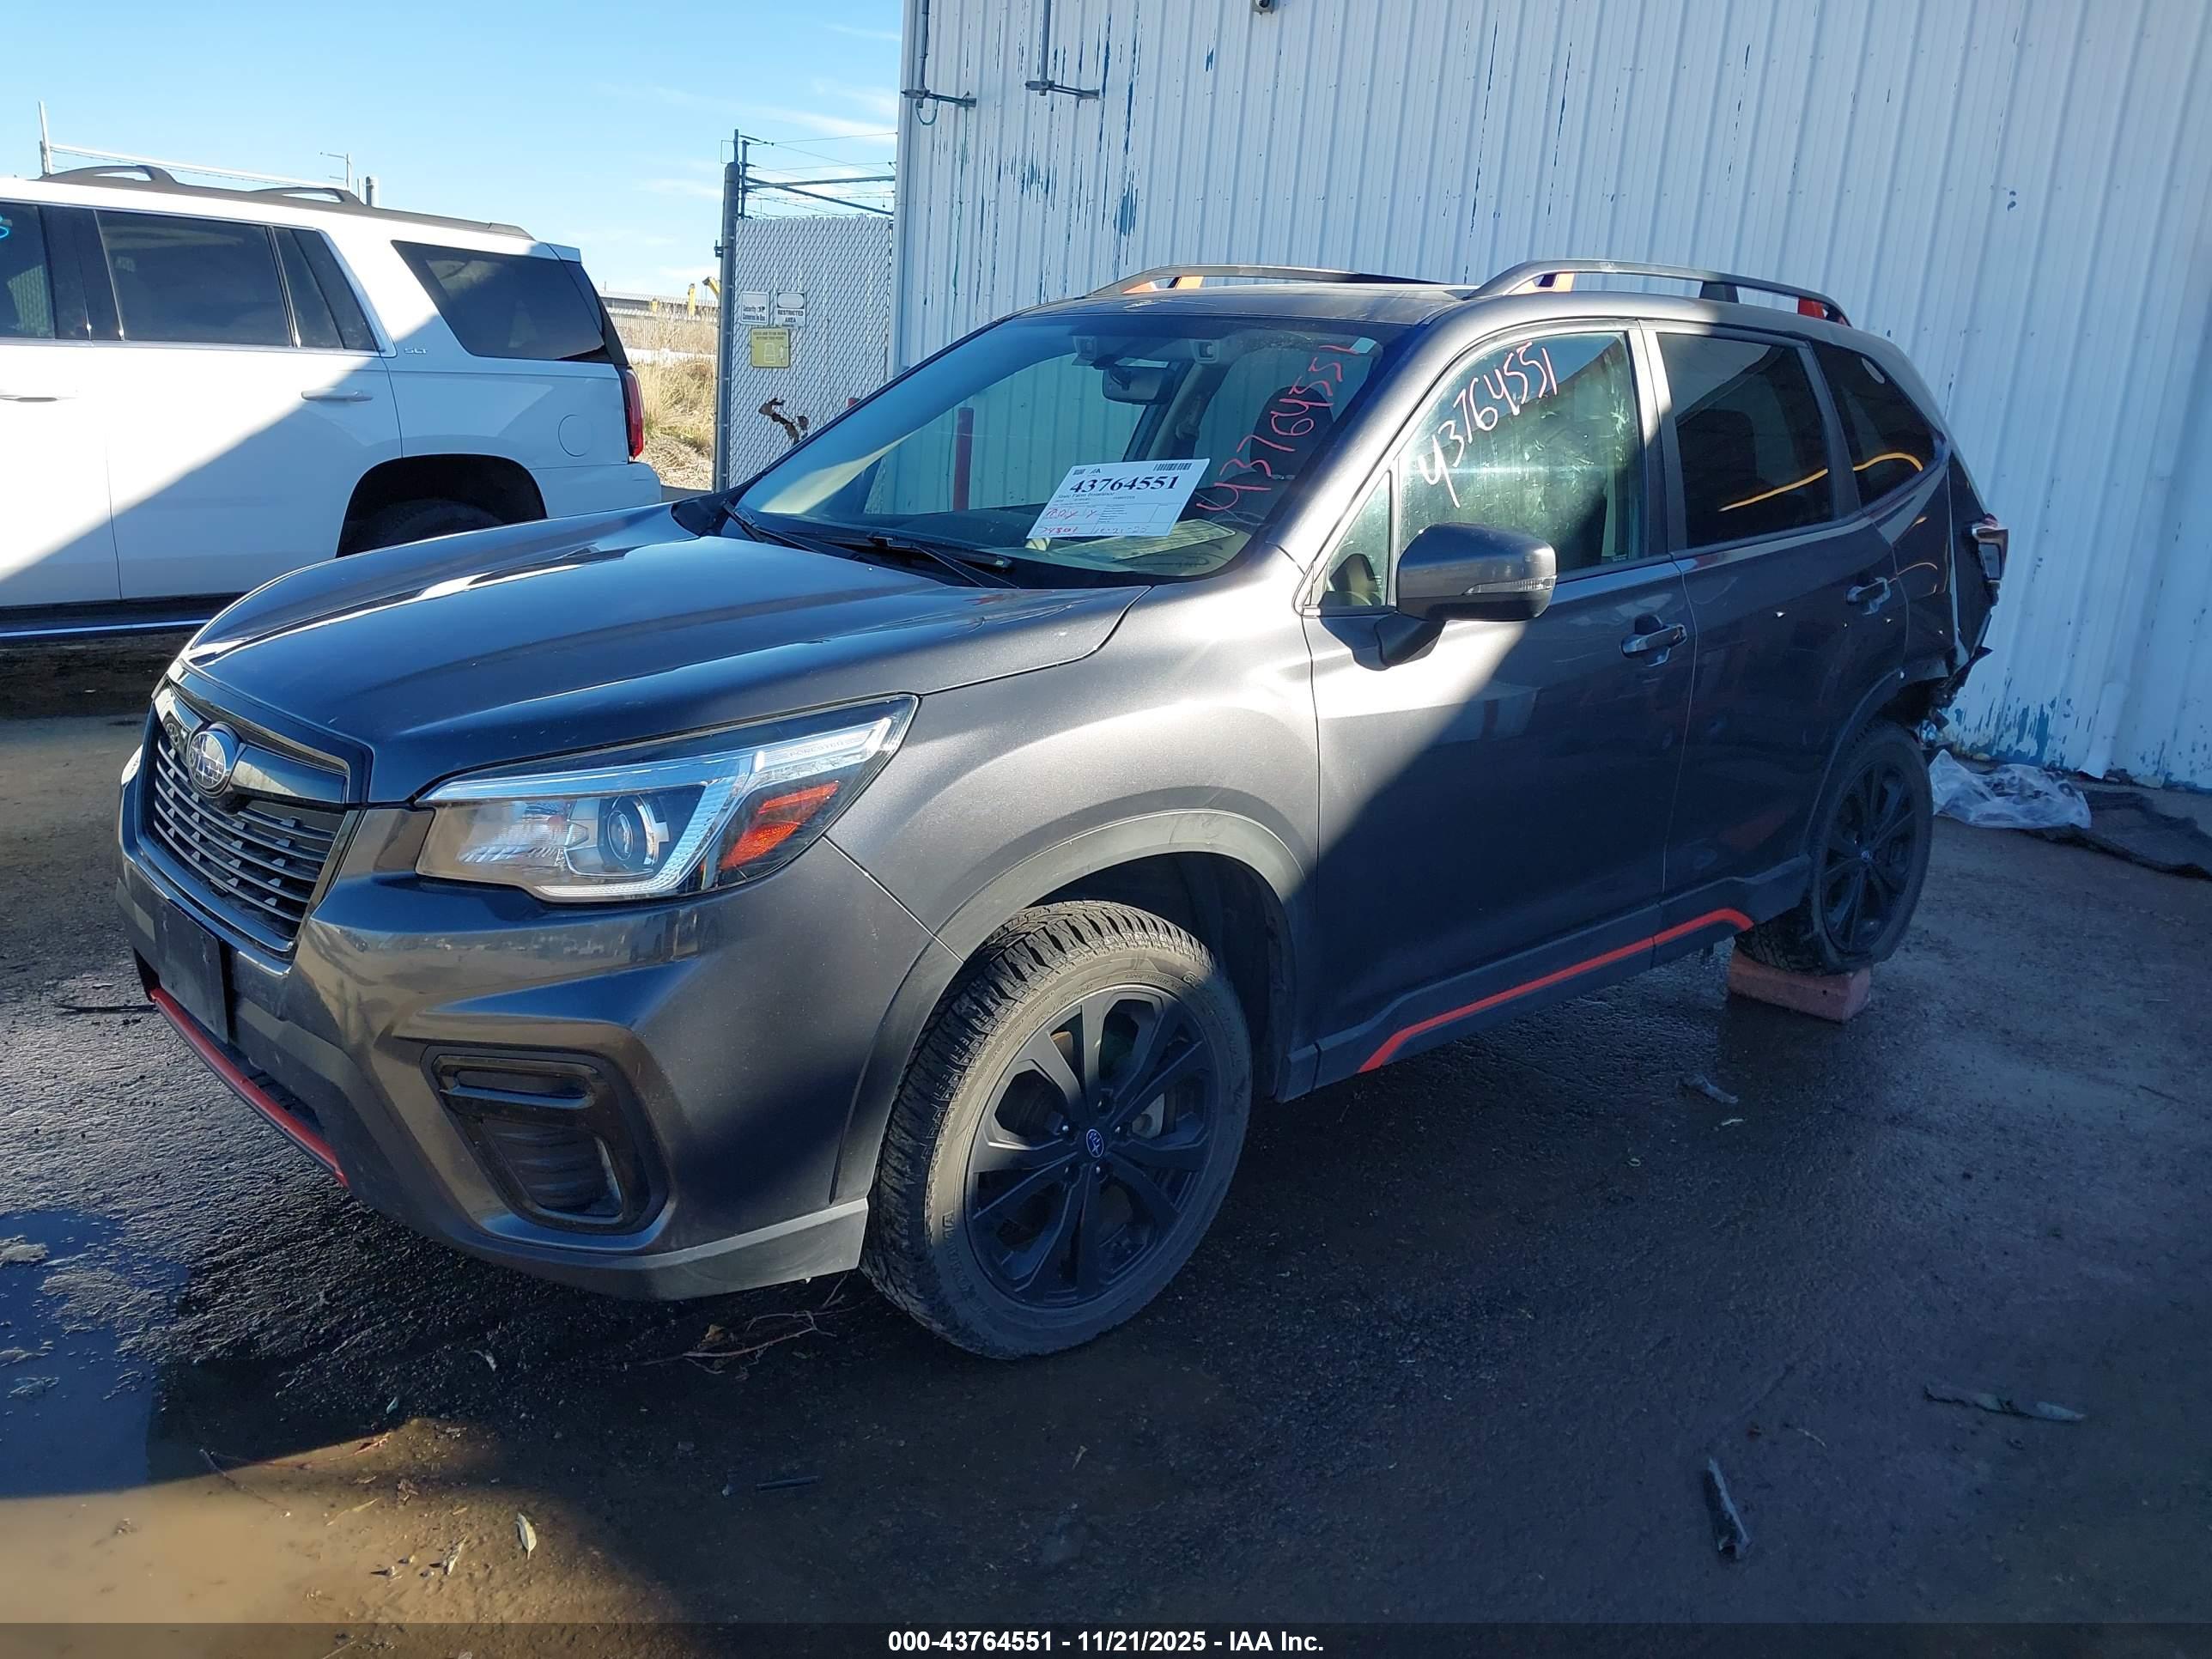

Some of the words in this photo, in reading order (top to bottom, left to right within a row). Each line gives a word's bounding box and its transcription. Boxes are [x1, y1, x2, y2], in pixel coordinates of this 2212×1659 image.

[1070, 476, 1179, 493] 43764551
[1196, 345, 1361, 511] 43764551
[1419, 342, 1557, 508] 43764551
